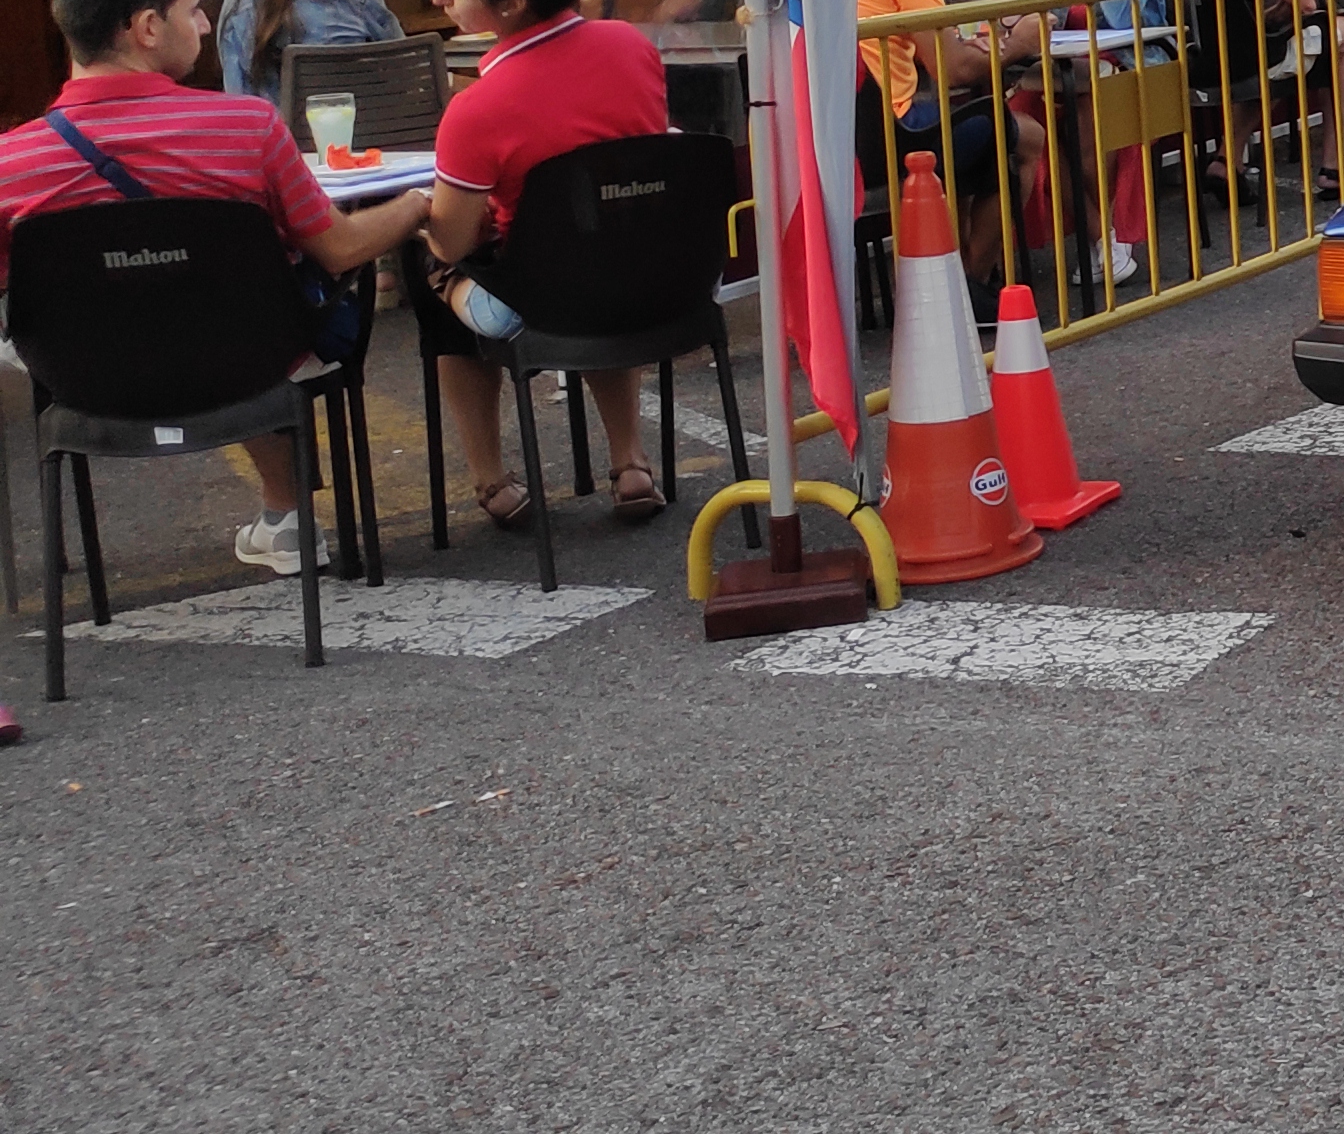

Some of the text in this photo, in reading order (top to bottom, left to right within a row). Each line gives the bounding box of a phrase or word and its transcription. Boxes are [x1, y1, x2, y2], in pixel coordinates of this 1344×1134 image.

[601, 180, 666, 201] Mahou
[103, 248, 189, 268] Mahou
[974, 472, 1006, 492] Gulf
